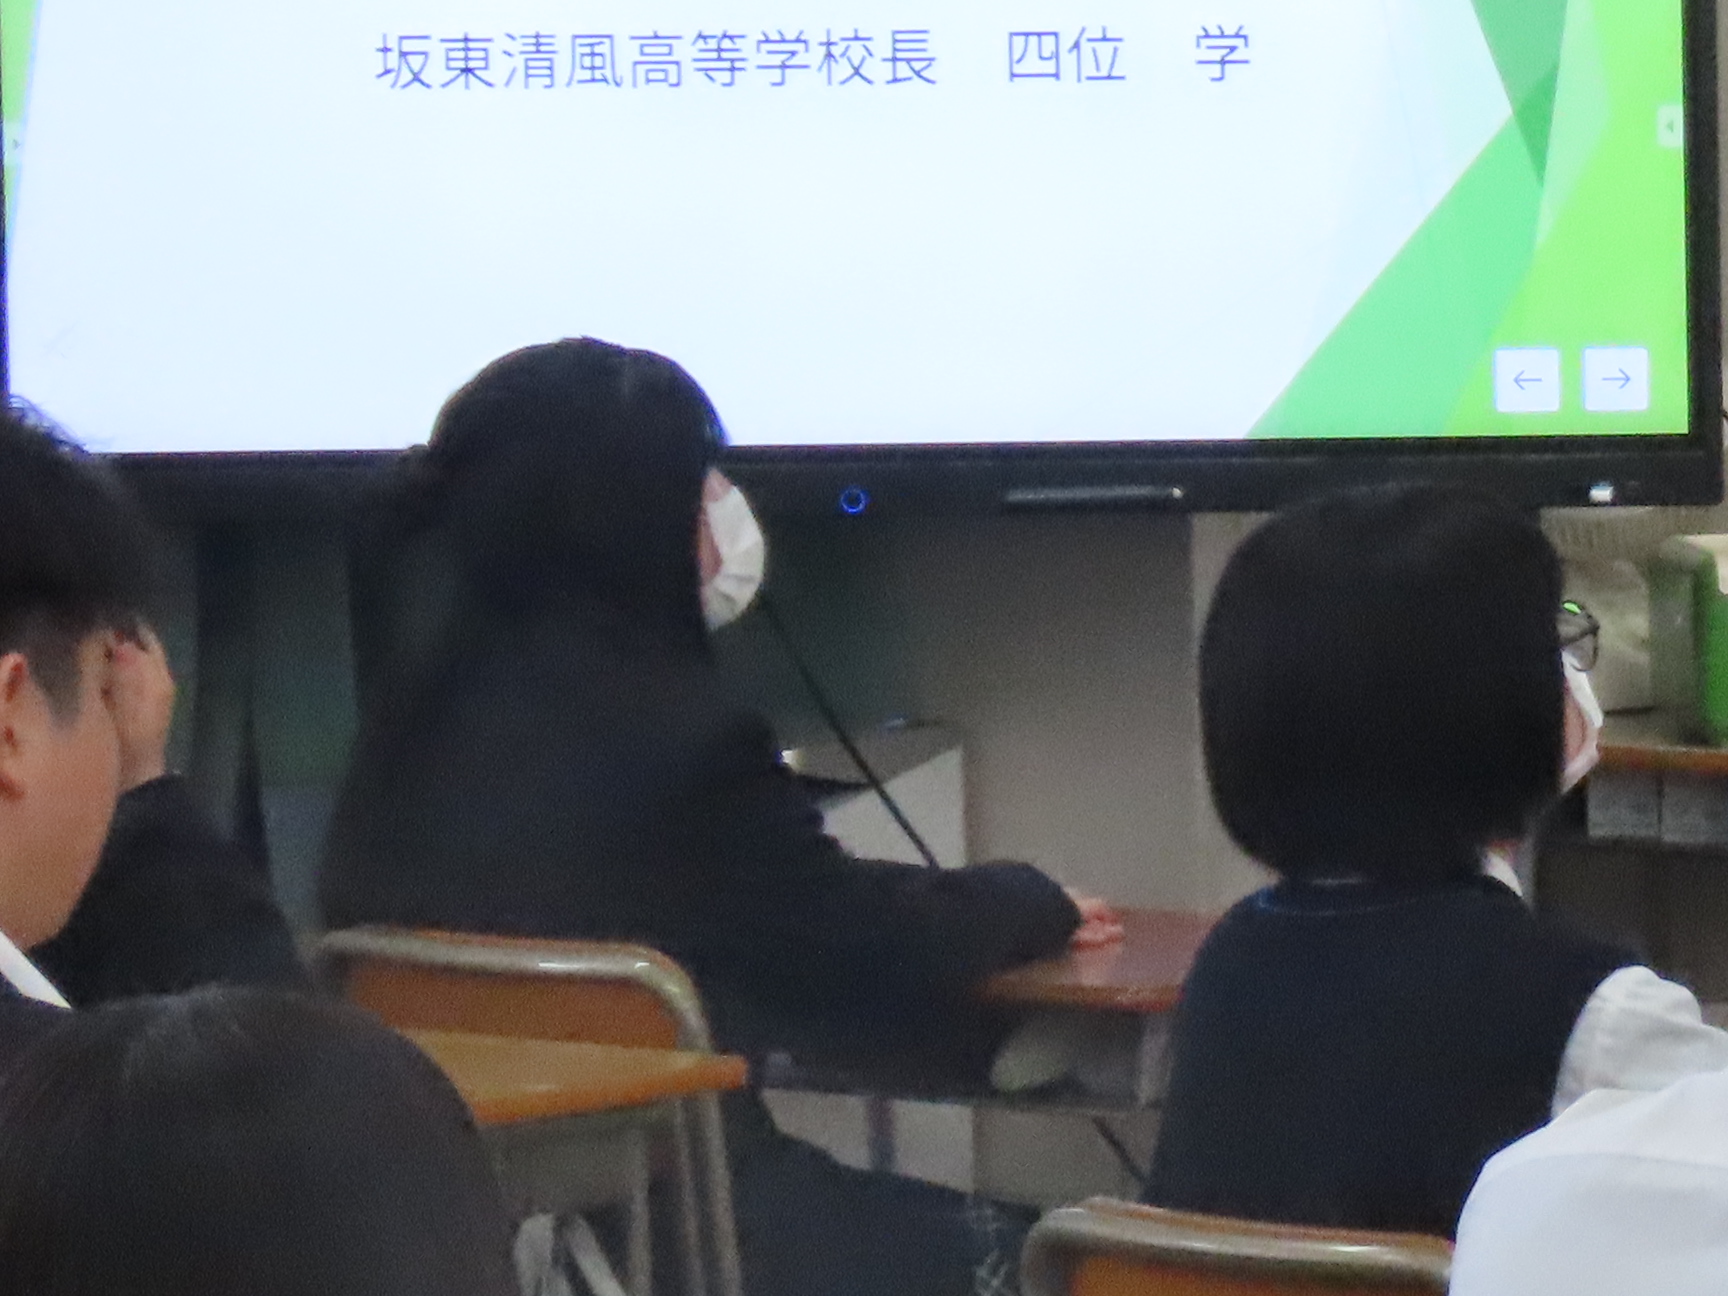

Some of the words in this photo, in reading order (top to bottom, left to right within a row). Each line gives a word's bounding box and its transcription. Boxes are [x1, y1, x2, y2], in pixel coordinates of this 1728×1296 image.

[374, 29, 938, 91] 坂東清風高等学校長
[1007, 25, 1128, 85] 四位
[1194, 22, 1252, 82] 学
